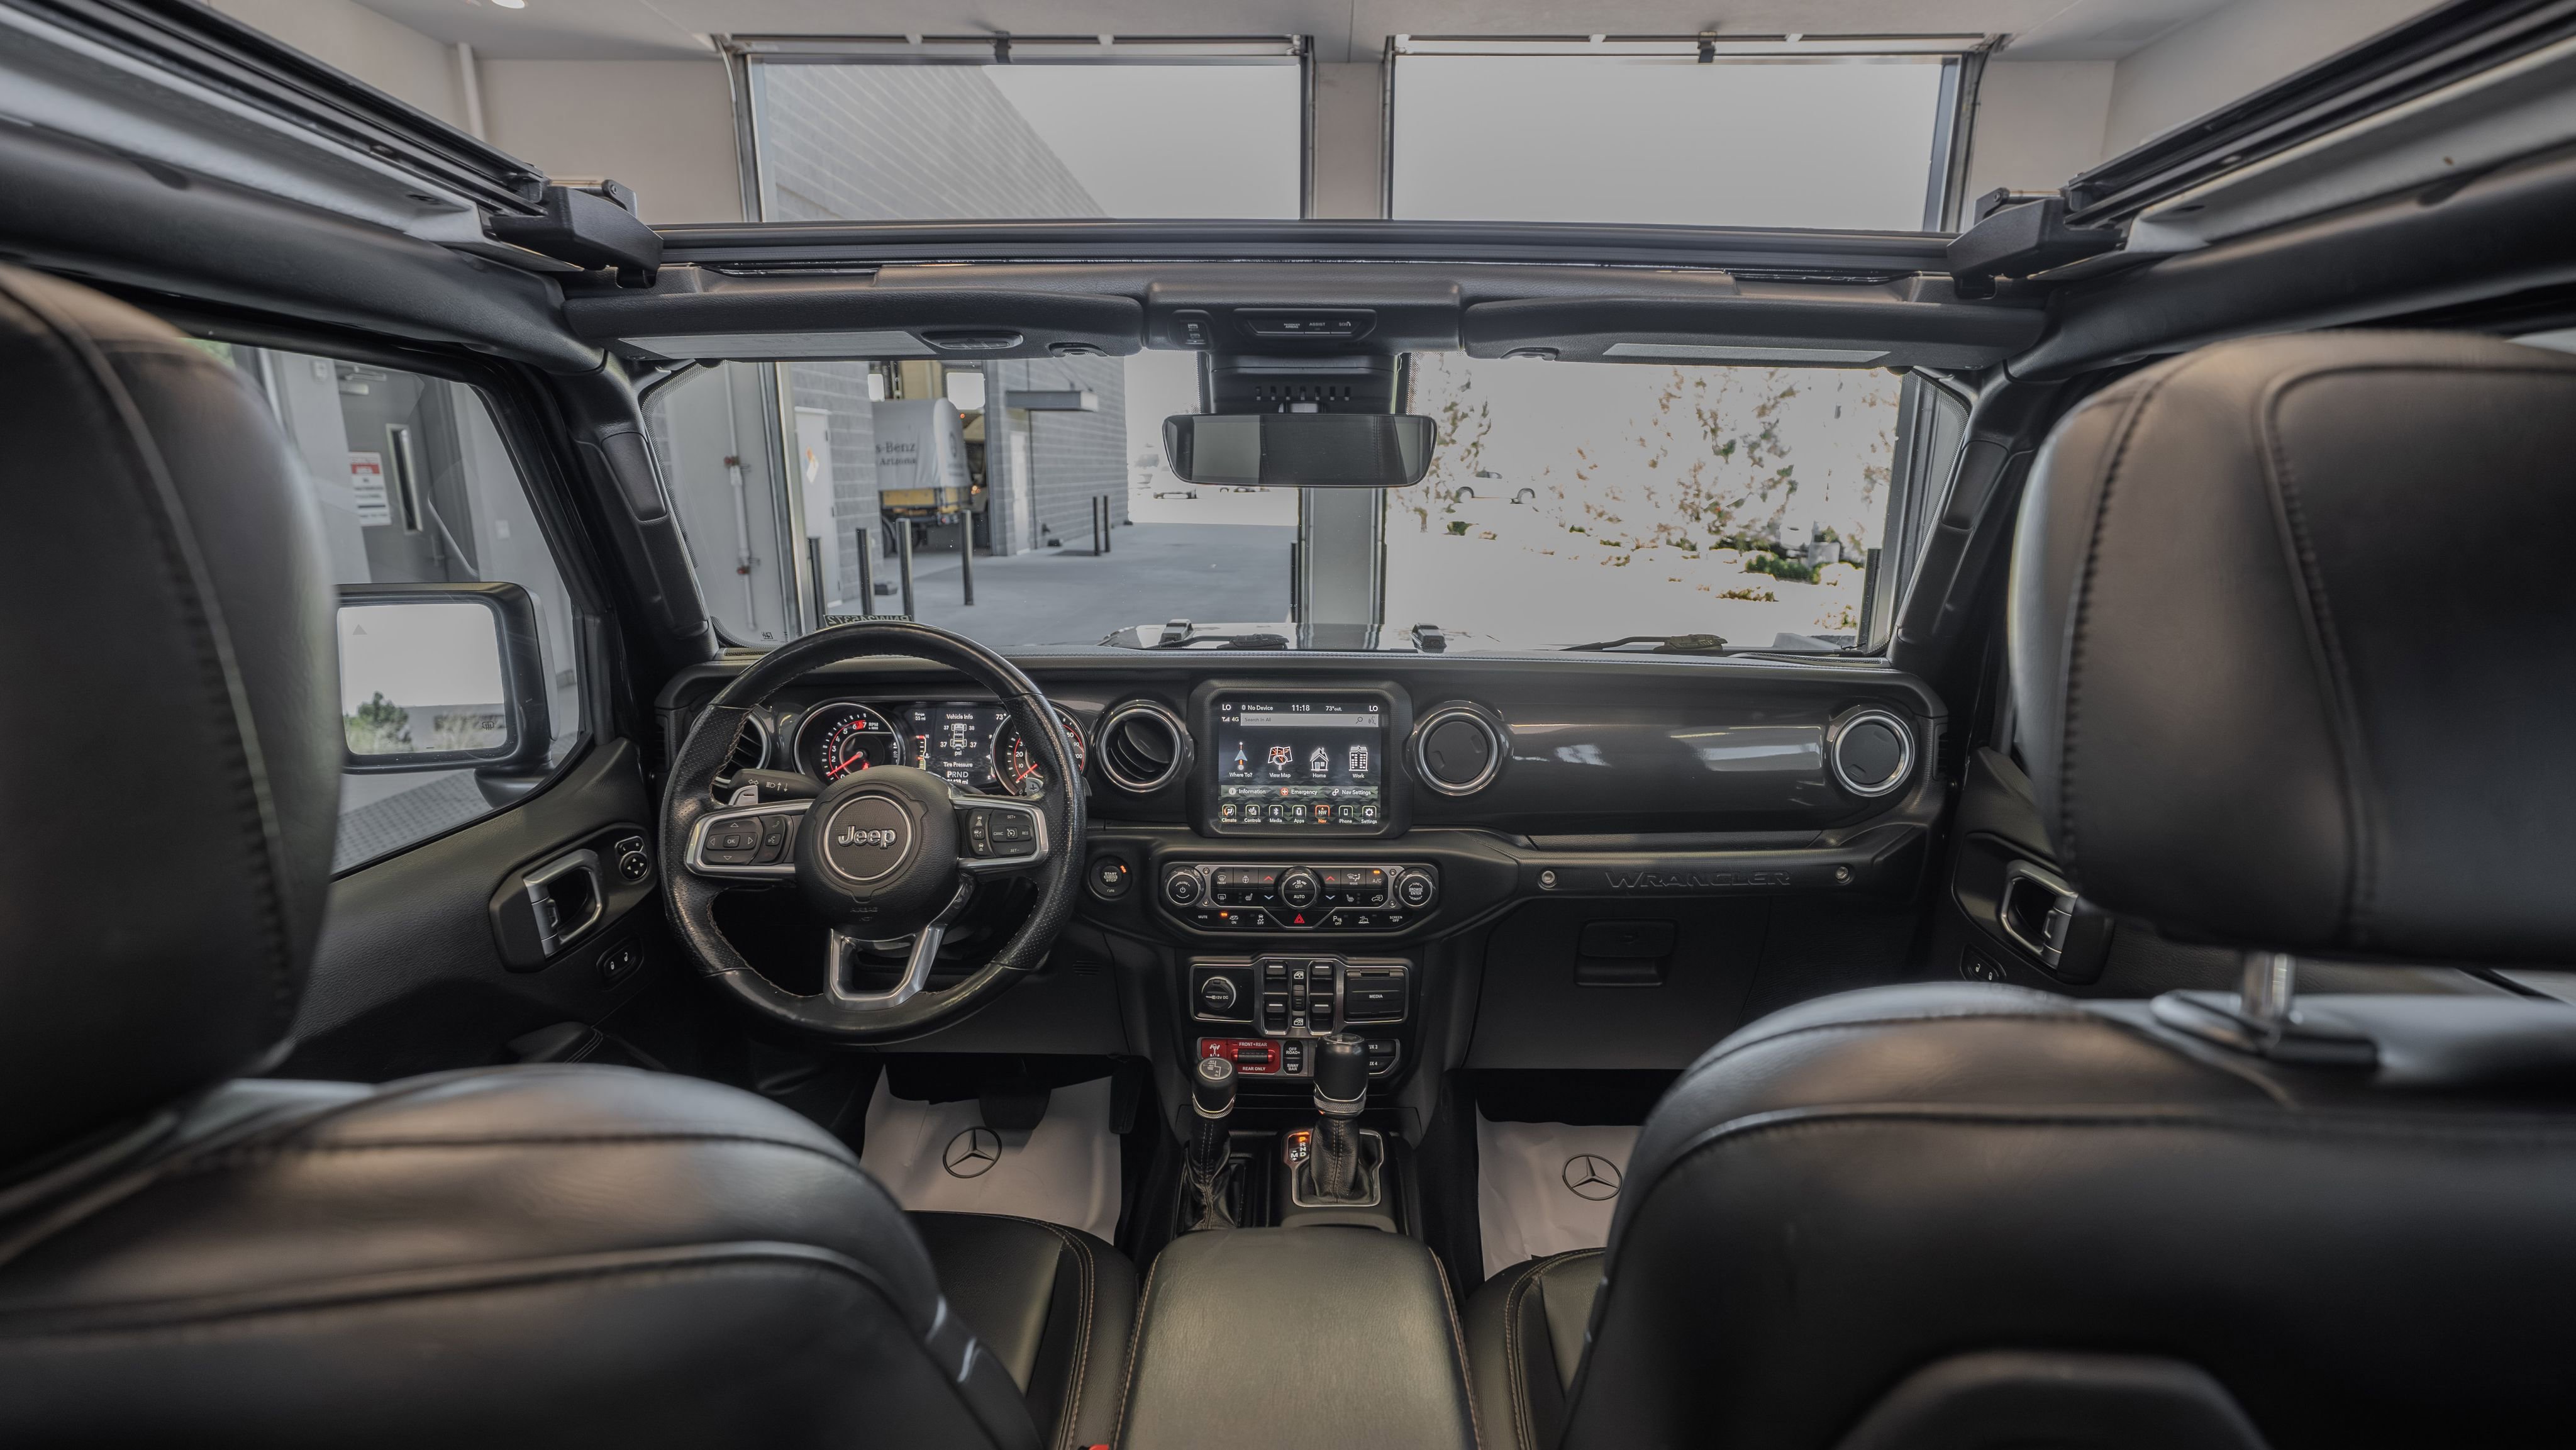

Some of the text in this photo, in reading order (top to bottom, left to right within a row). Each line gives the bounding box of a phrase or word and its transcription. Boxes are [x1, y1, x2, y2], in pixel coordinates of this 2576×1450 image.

[880, 457, 917, 466] Arizona
[838, 825, 897, 849] Jeep
[1605, 871, 1791, 888] WRANGLER
